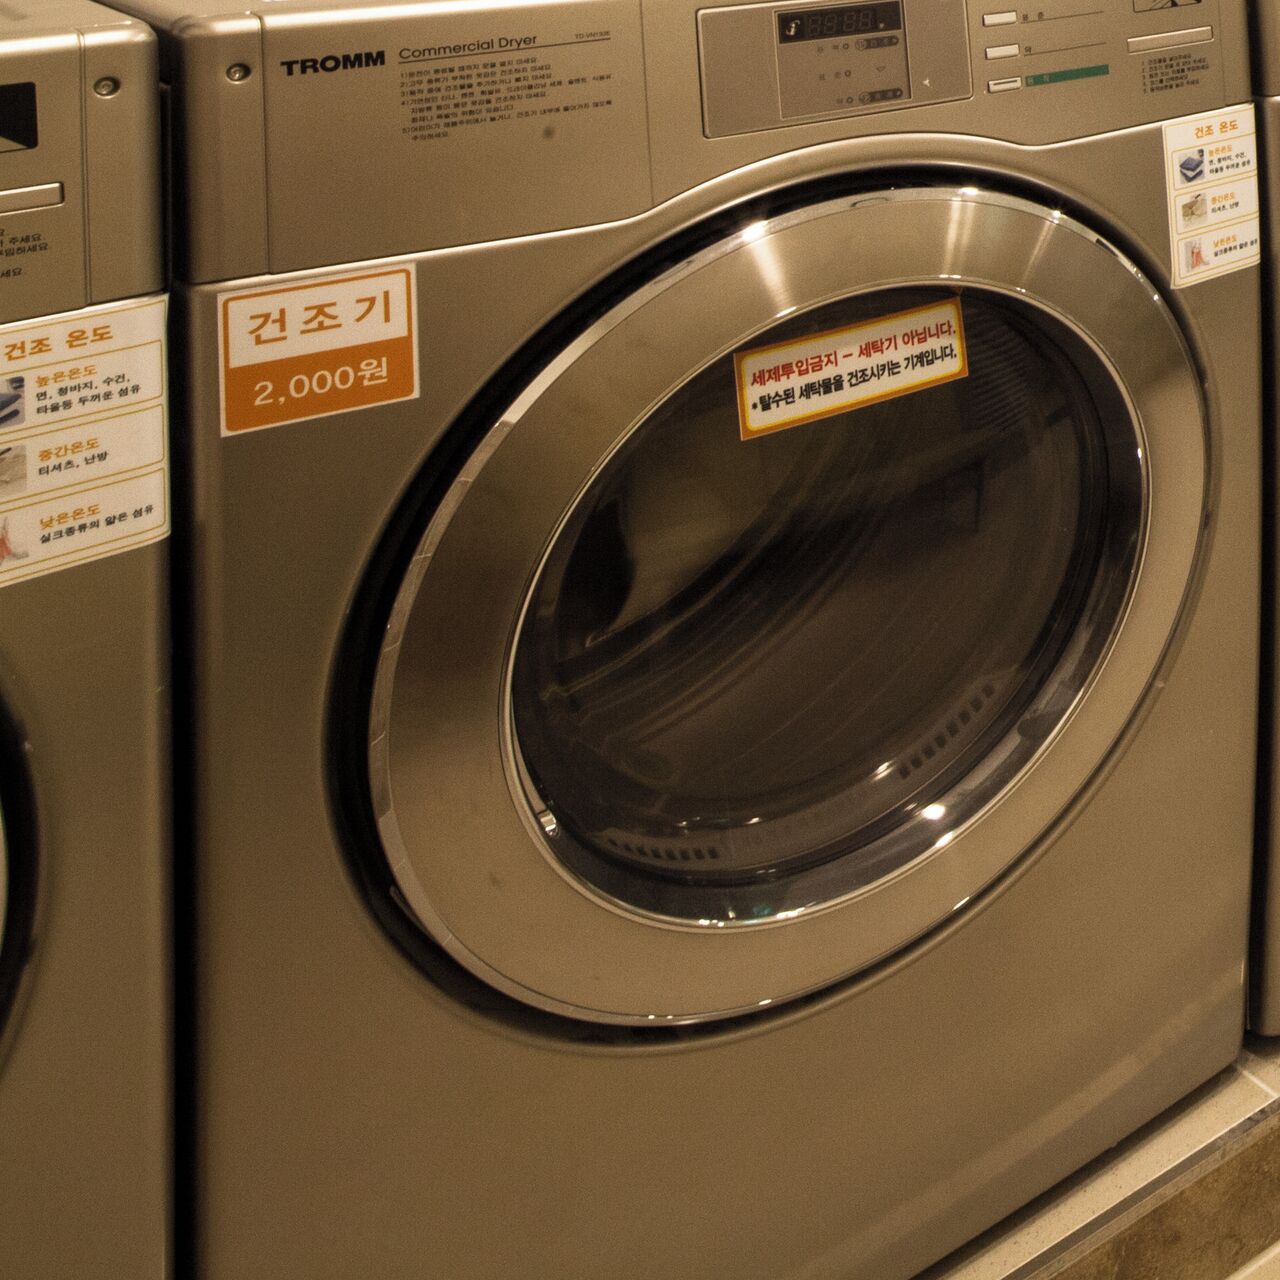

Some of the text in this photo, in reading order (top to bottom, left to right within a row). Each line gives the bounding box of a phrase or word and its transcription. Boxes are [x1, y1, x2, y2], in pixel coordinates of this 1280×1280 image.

[280, 50, 386, 76] TROMM
[399, 40, 495, 60] Commercial
[498, 34, 537, 54] Dryer
[1193, 119, 1238, 139] 건조 온도
[249, 290, 392, 346] 건조기
[2, 324, 113, 361] 건조 온도
[750, 319, 956, 386] 세제투입금지 세탁기 아닙니다.
[35, 364, 97, 388] 높은온도
[252, 356, 390, 408] 2,000원
[758, 343, 957, 412] 탈수된 세탁물을 건조시키는 기계입니다.
[35, 383, 141, 414] 타올등 두꺼운 섬유
[37, 437, 100, 462] 중간온도
[38, 503, 101, 530] 낮은온도
[38, 519, 100, 544] 실크종류의
[132, 504, 153, 519] 섬유
